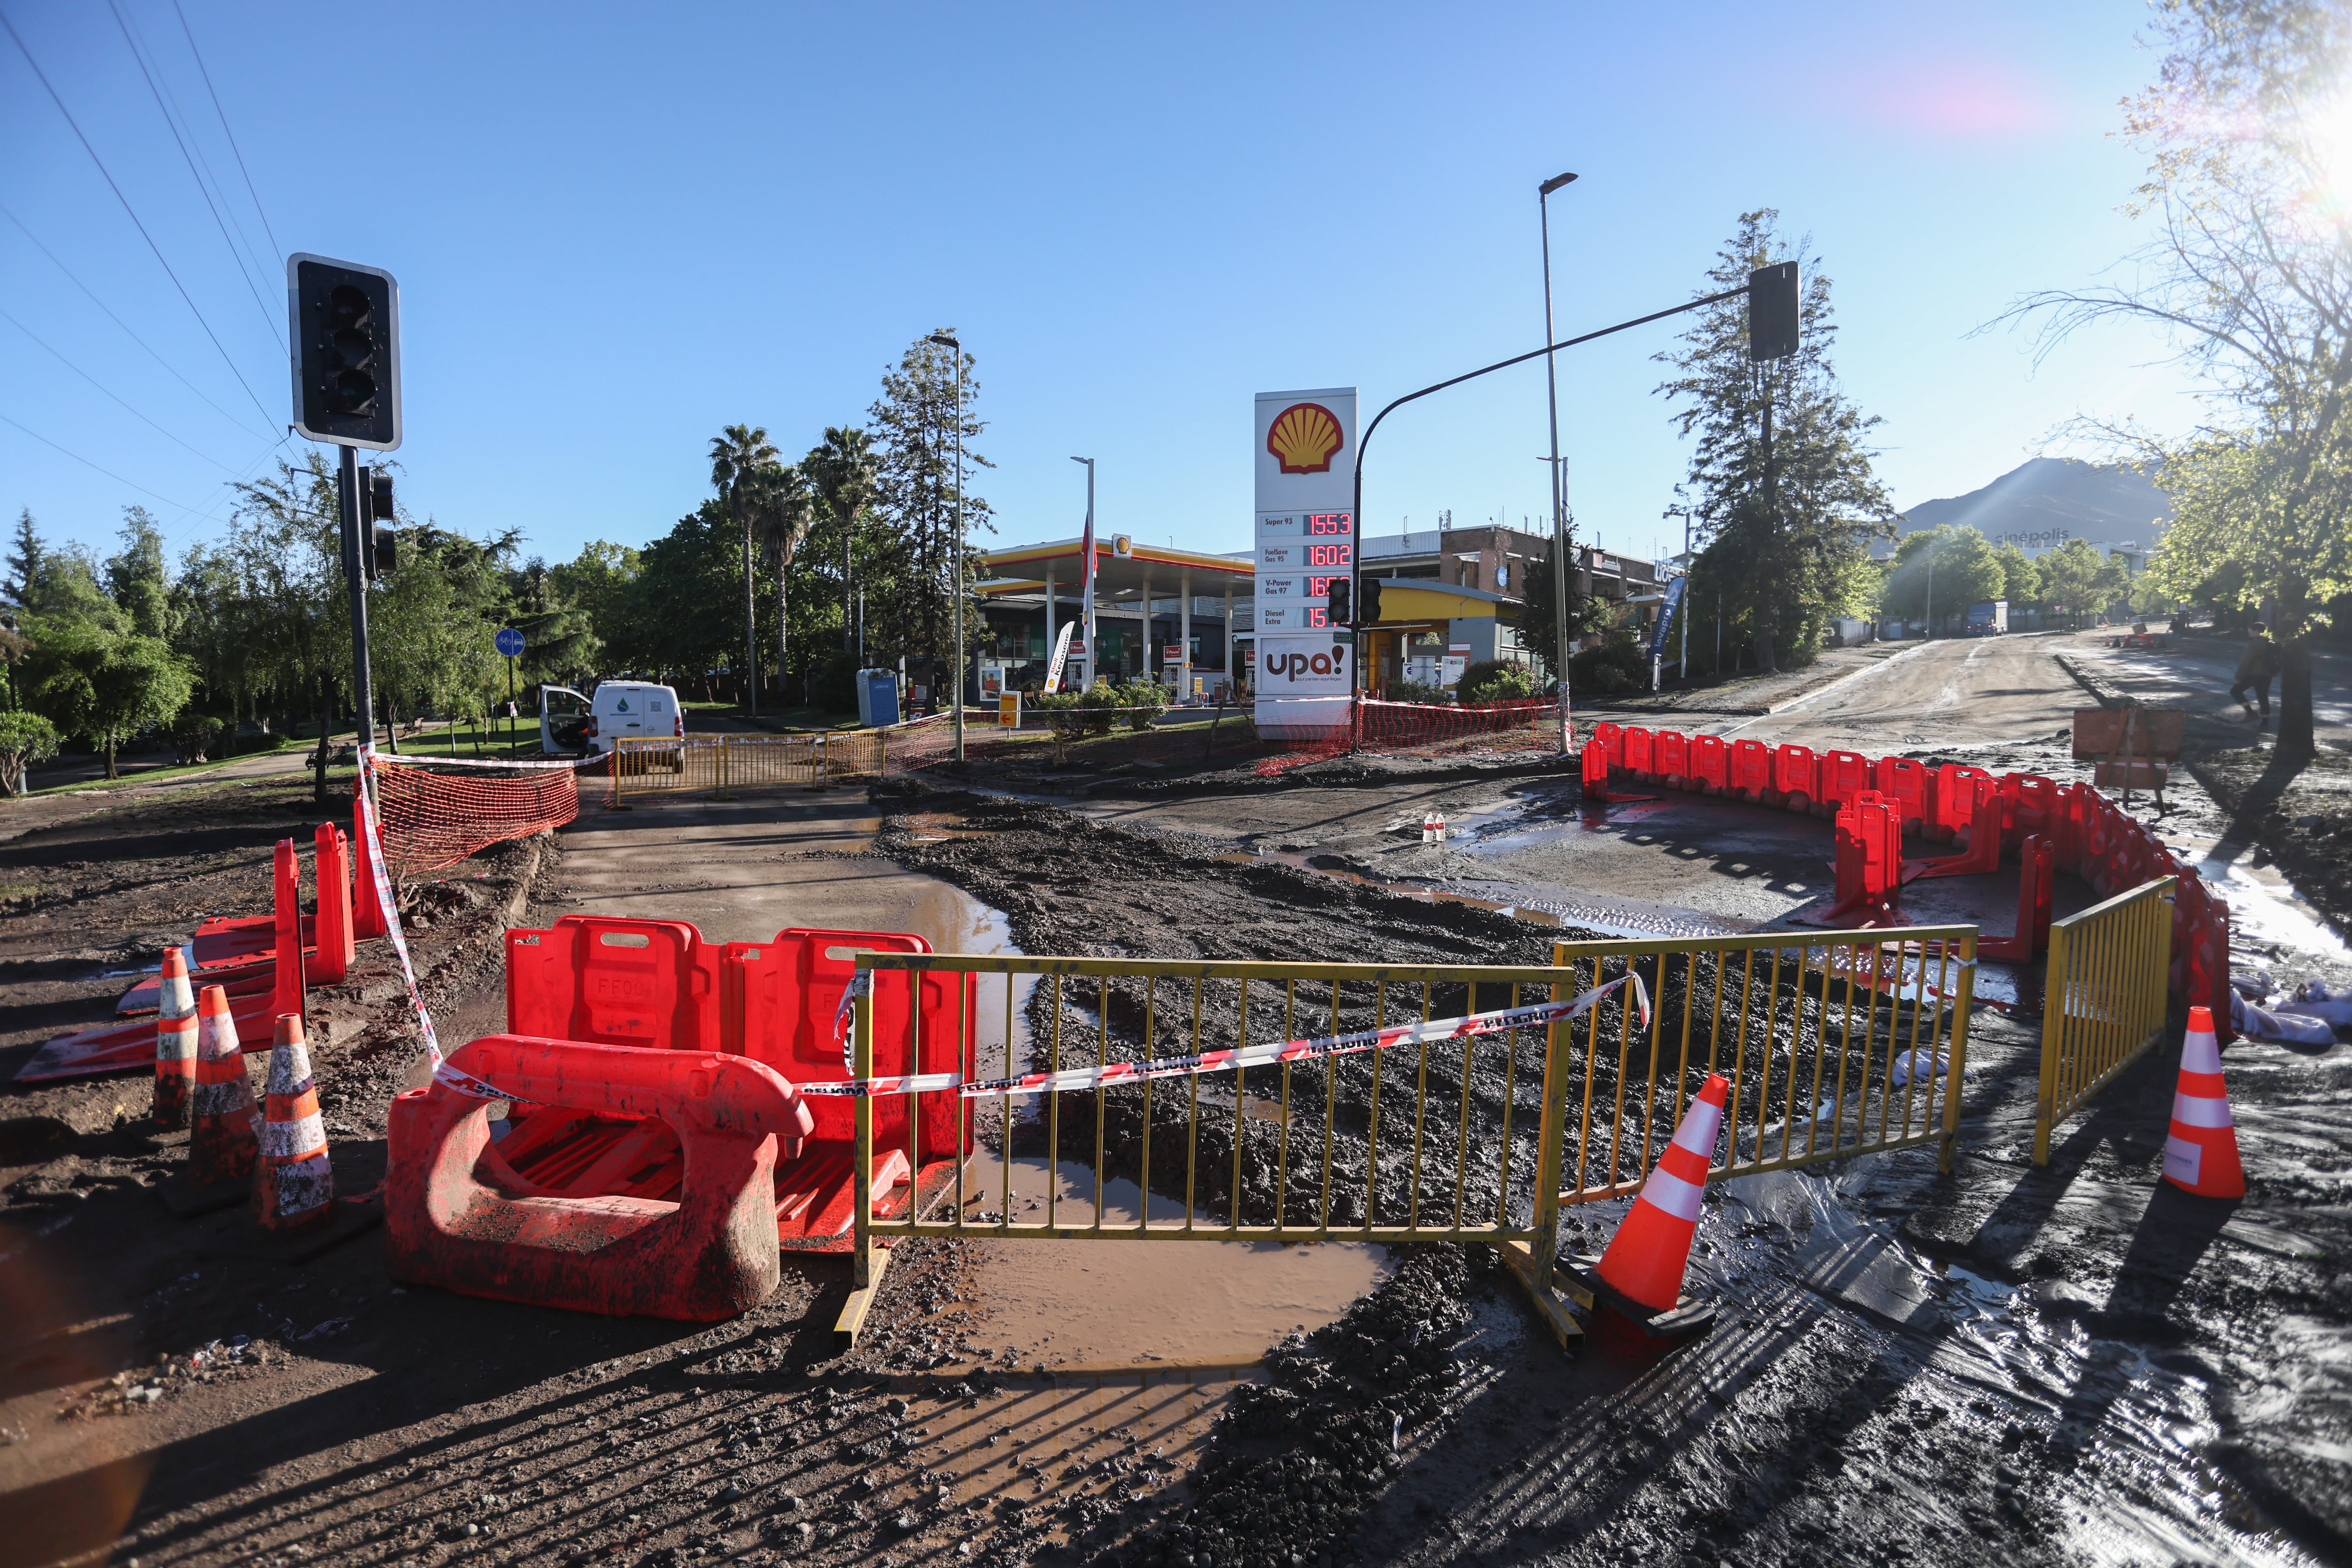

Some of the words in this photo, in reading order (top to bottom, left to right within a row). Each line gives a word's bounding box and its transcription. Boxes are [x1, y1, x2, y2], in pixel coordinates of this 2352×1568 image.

[1310, 514, 1351, 534] 1553
[1995, 528, 2069, 543] cinépolis
[1310, 545, 1351, 566] 1602
[1310, 576, 1350, 597] 165
[1055, 633, 1069, 676] Kerosene
[1267, 645, 1344, 682] upa!
